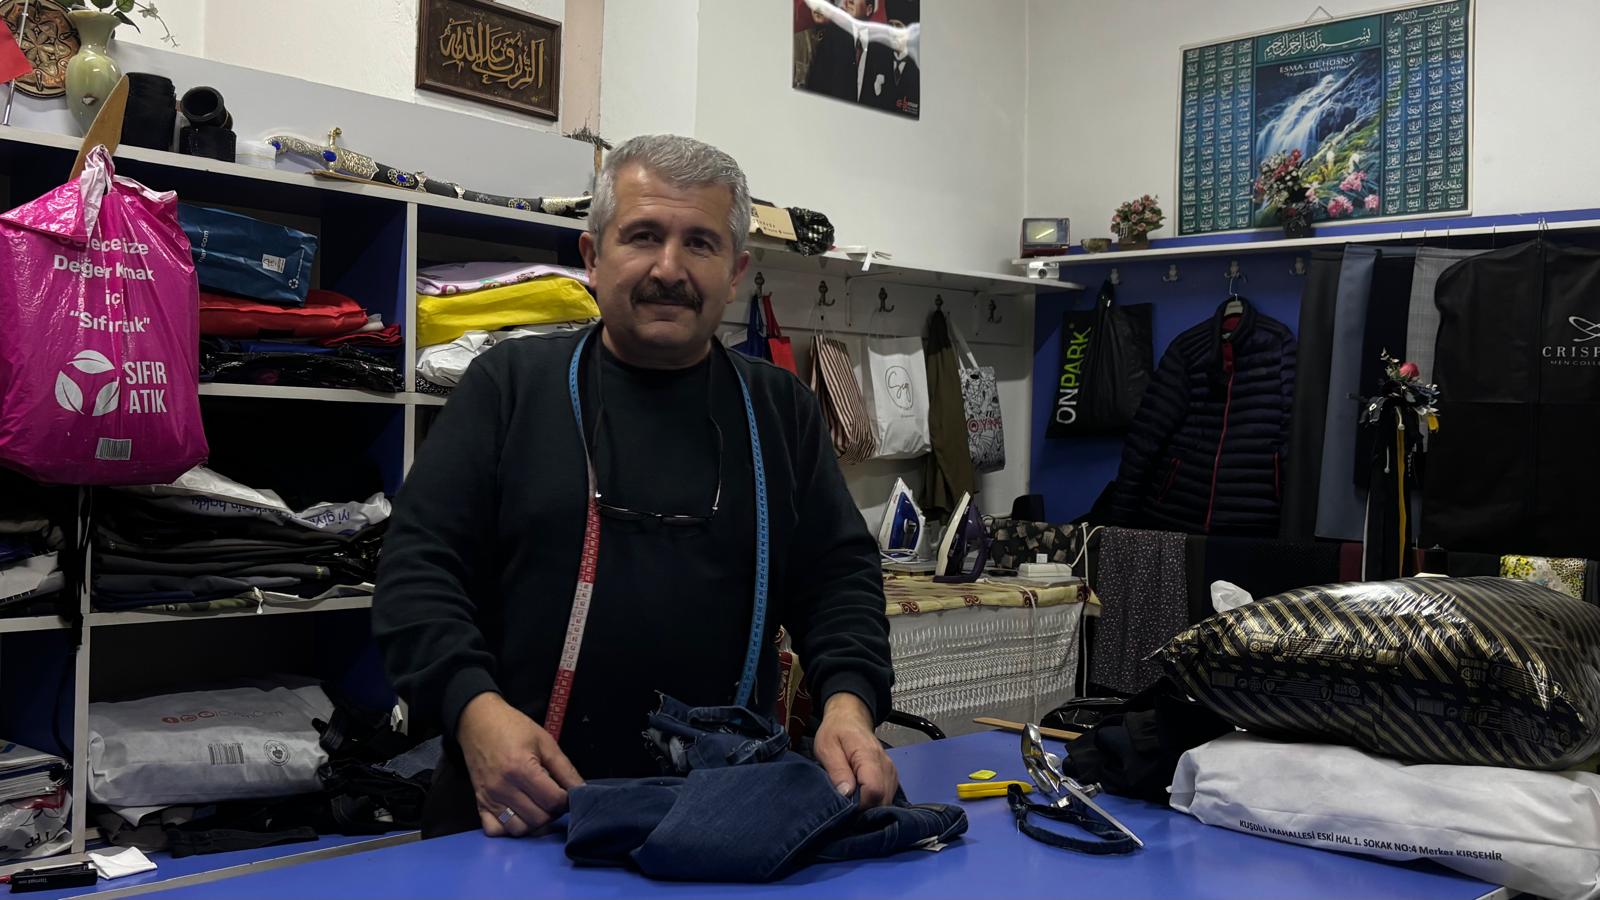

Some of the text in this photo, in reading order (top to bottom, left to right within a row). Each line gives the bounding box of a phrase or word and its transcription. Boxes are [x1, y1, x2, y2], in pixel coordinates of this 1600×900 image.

[54, 254, 112, 279] Değer
[124, 361, 167, 385] SIFIR
[129, 389, 167, 414] ATIK
[1317, 831, 1334, 842] ESKİ
[1335, 834, 1352, 845] HAL
[1354, 836, 1362, 847] 1.
[1363, 838, 1393, 850] SOKAK
[1394, 842, 1418, 853] NO:4
[1419, 845, 1455, 856] Merkez
